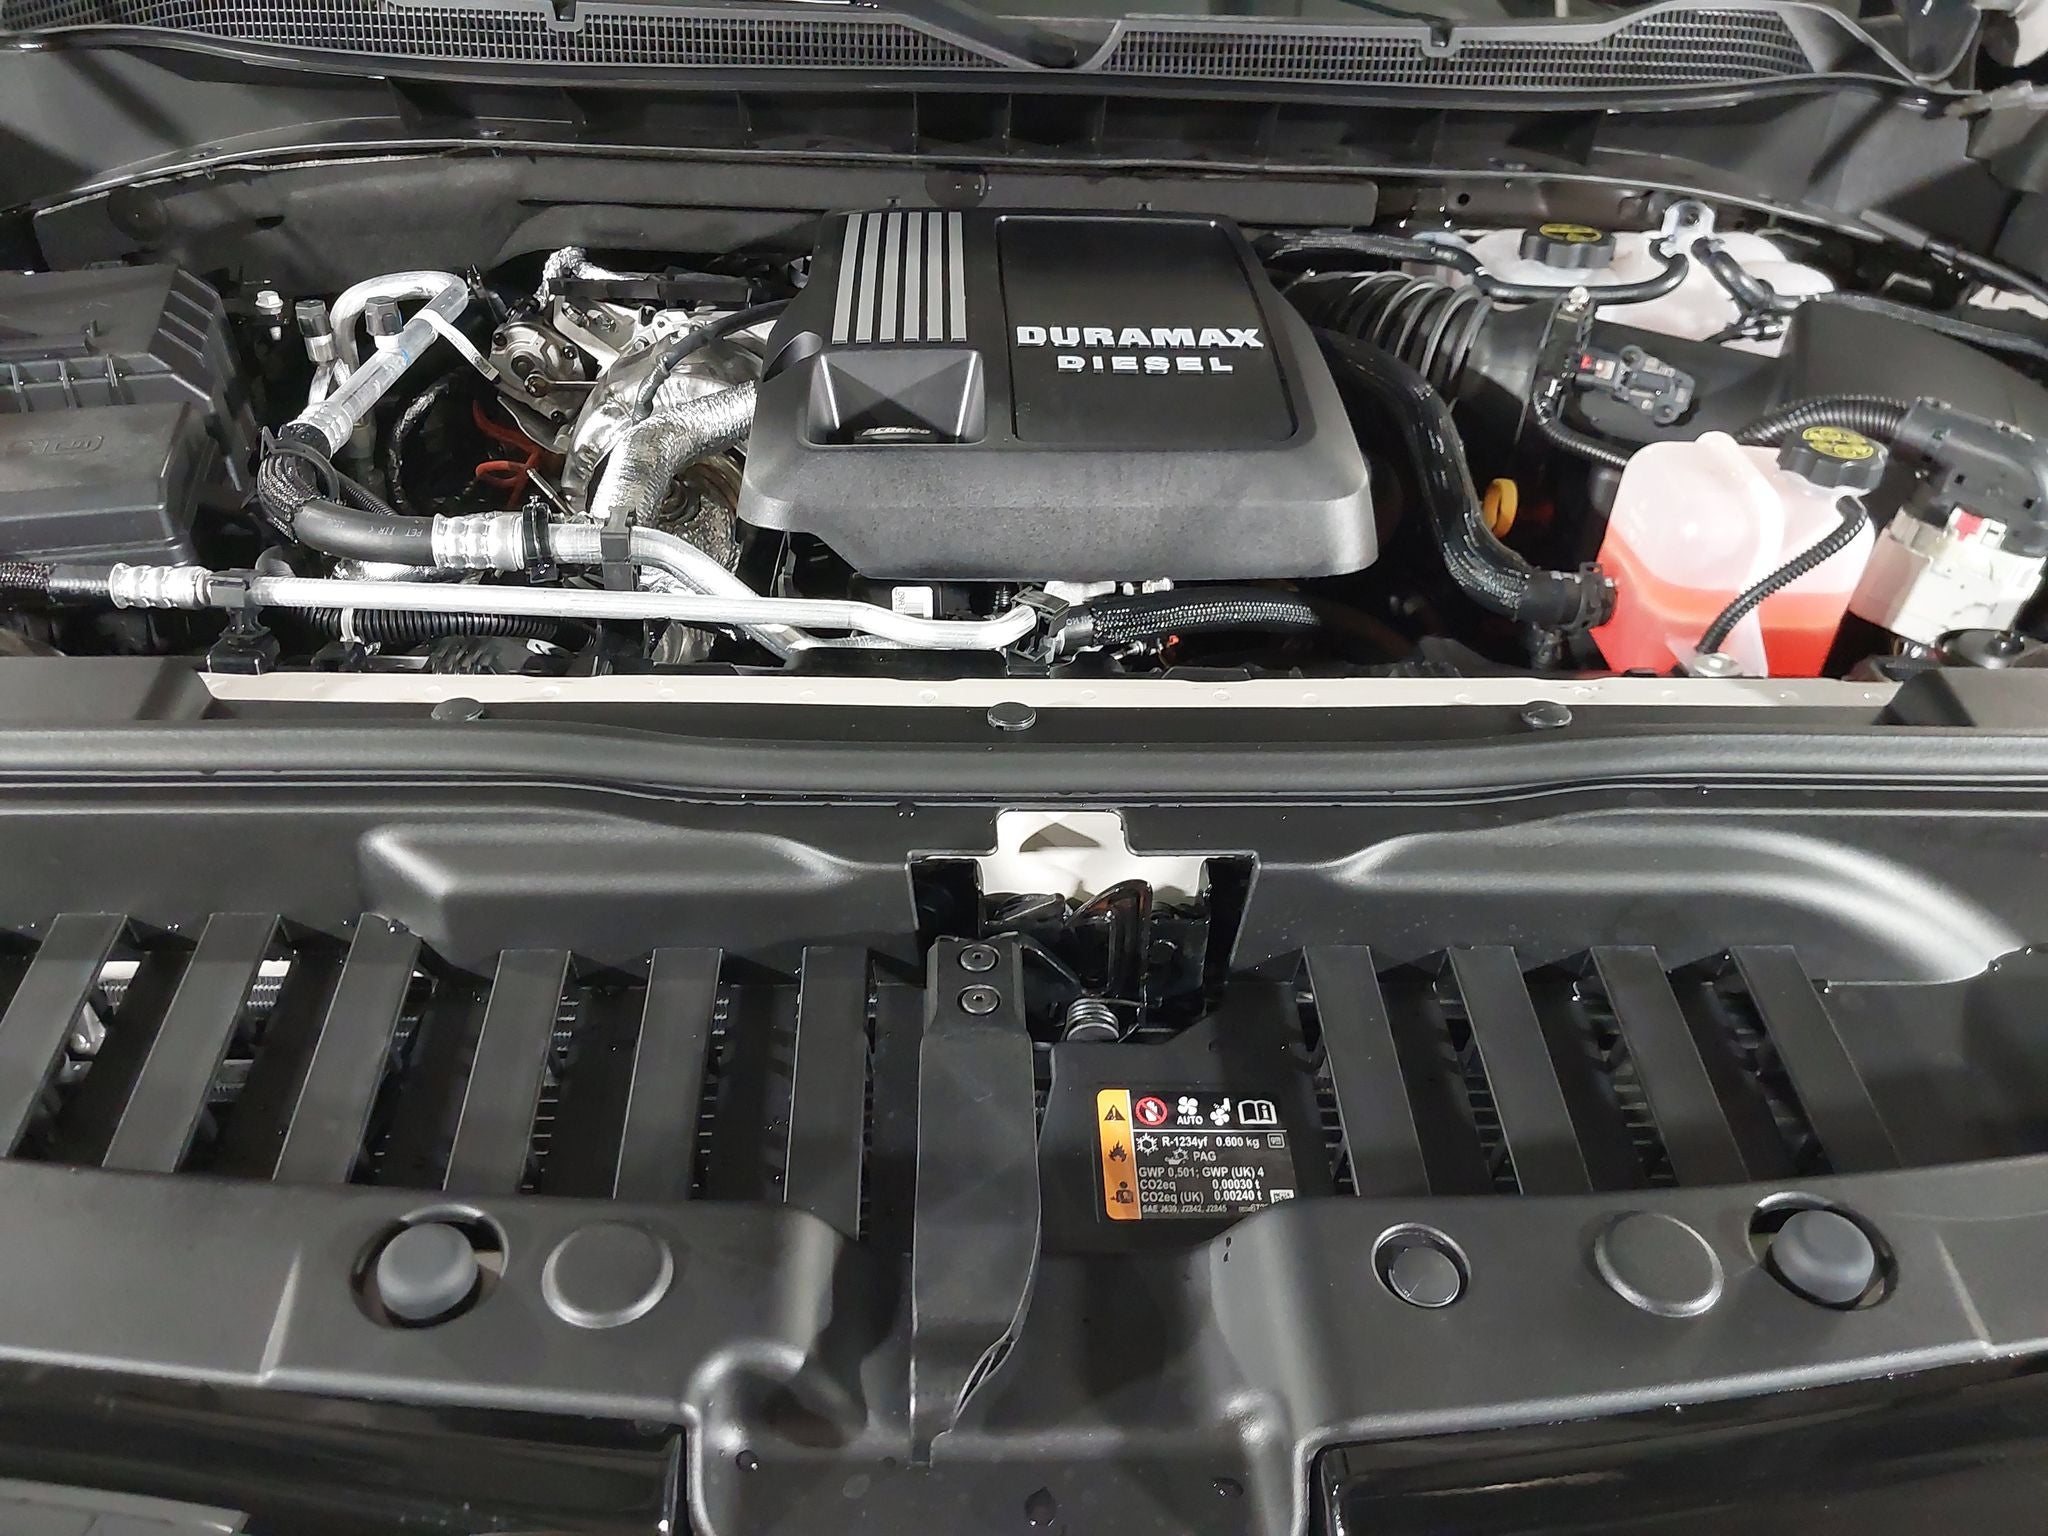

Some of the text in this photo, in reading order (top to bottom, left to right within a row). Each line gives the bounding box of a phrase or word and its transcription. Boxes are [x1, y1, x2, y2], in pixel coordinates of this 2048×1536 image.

[1016, 326, 1264, 348] DURAMAX
[1057, 355, 1234, 374] DIESEL
[1177, 1115, 1204, 1126] AUTO
[1161, 1136, 1208, 1149] R-1234yf
[1246, 1136, 1260, 1149] kg
[1192, 1150, 1217, 1161] PAG
[1138, 1166, 1265, 1180] GWP 0,501; GWP (UK) 4
[1140, 1179, 1176, 1192] CO2eq
[1254, 1179, 1261, 1190] t
[1141, 1191, 1178, 1204] CO2eq
[1180, 1191, 1204, 1205] (UK)
[1256, 1190, 1263, 1201] t
[1142, 1204, 1159, 1213] SAE
